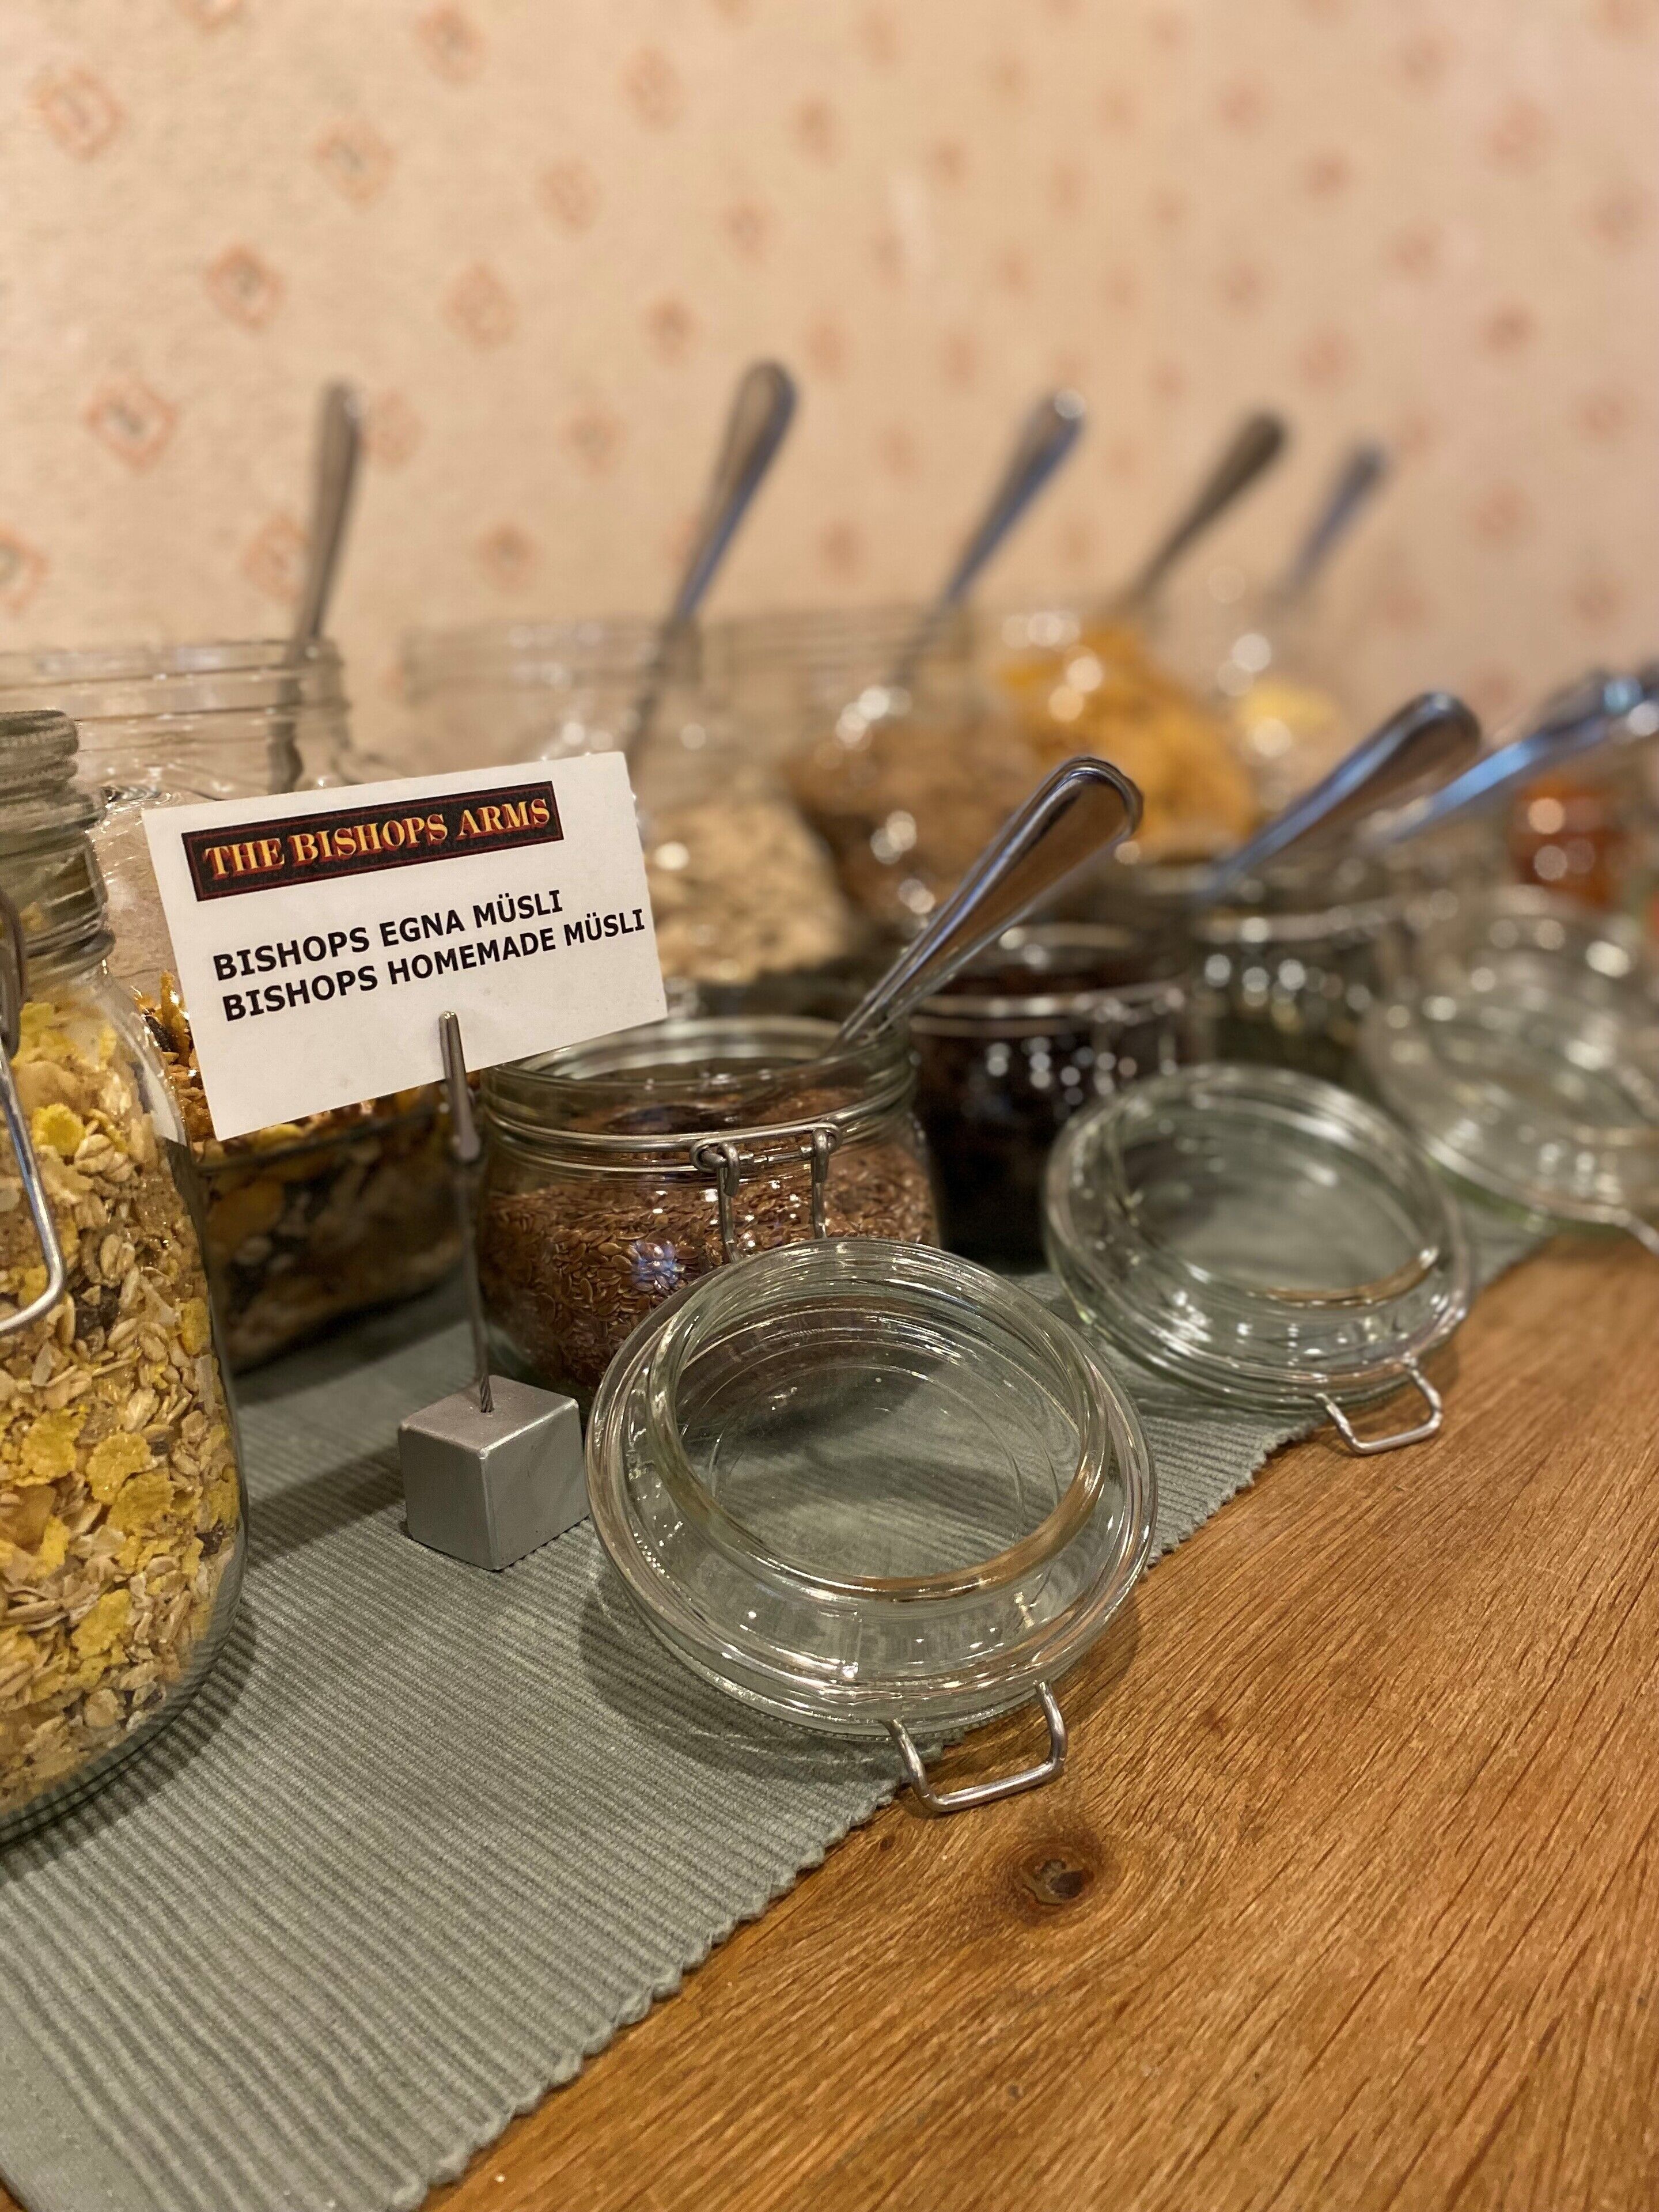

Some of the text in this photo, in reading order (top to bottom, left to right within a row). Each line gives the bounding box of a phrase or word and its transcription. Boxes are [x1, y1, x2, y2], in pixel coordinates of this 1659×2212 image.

[203, 799, 550, 879] THE BISHOPS ARMS
[213, 889, 563, 981] BISHOPS EGNA MÜSLI
[222, 908, 645, 1022] BISHOPS HOMEMADE MÜSLI
